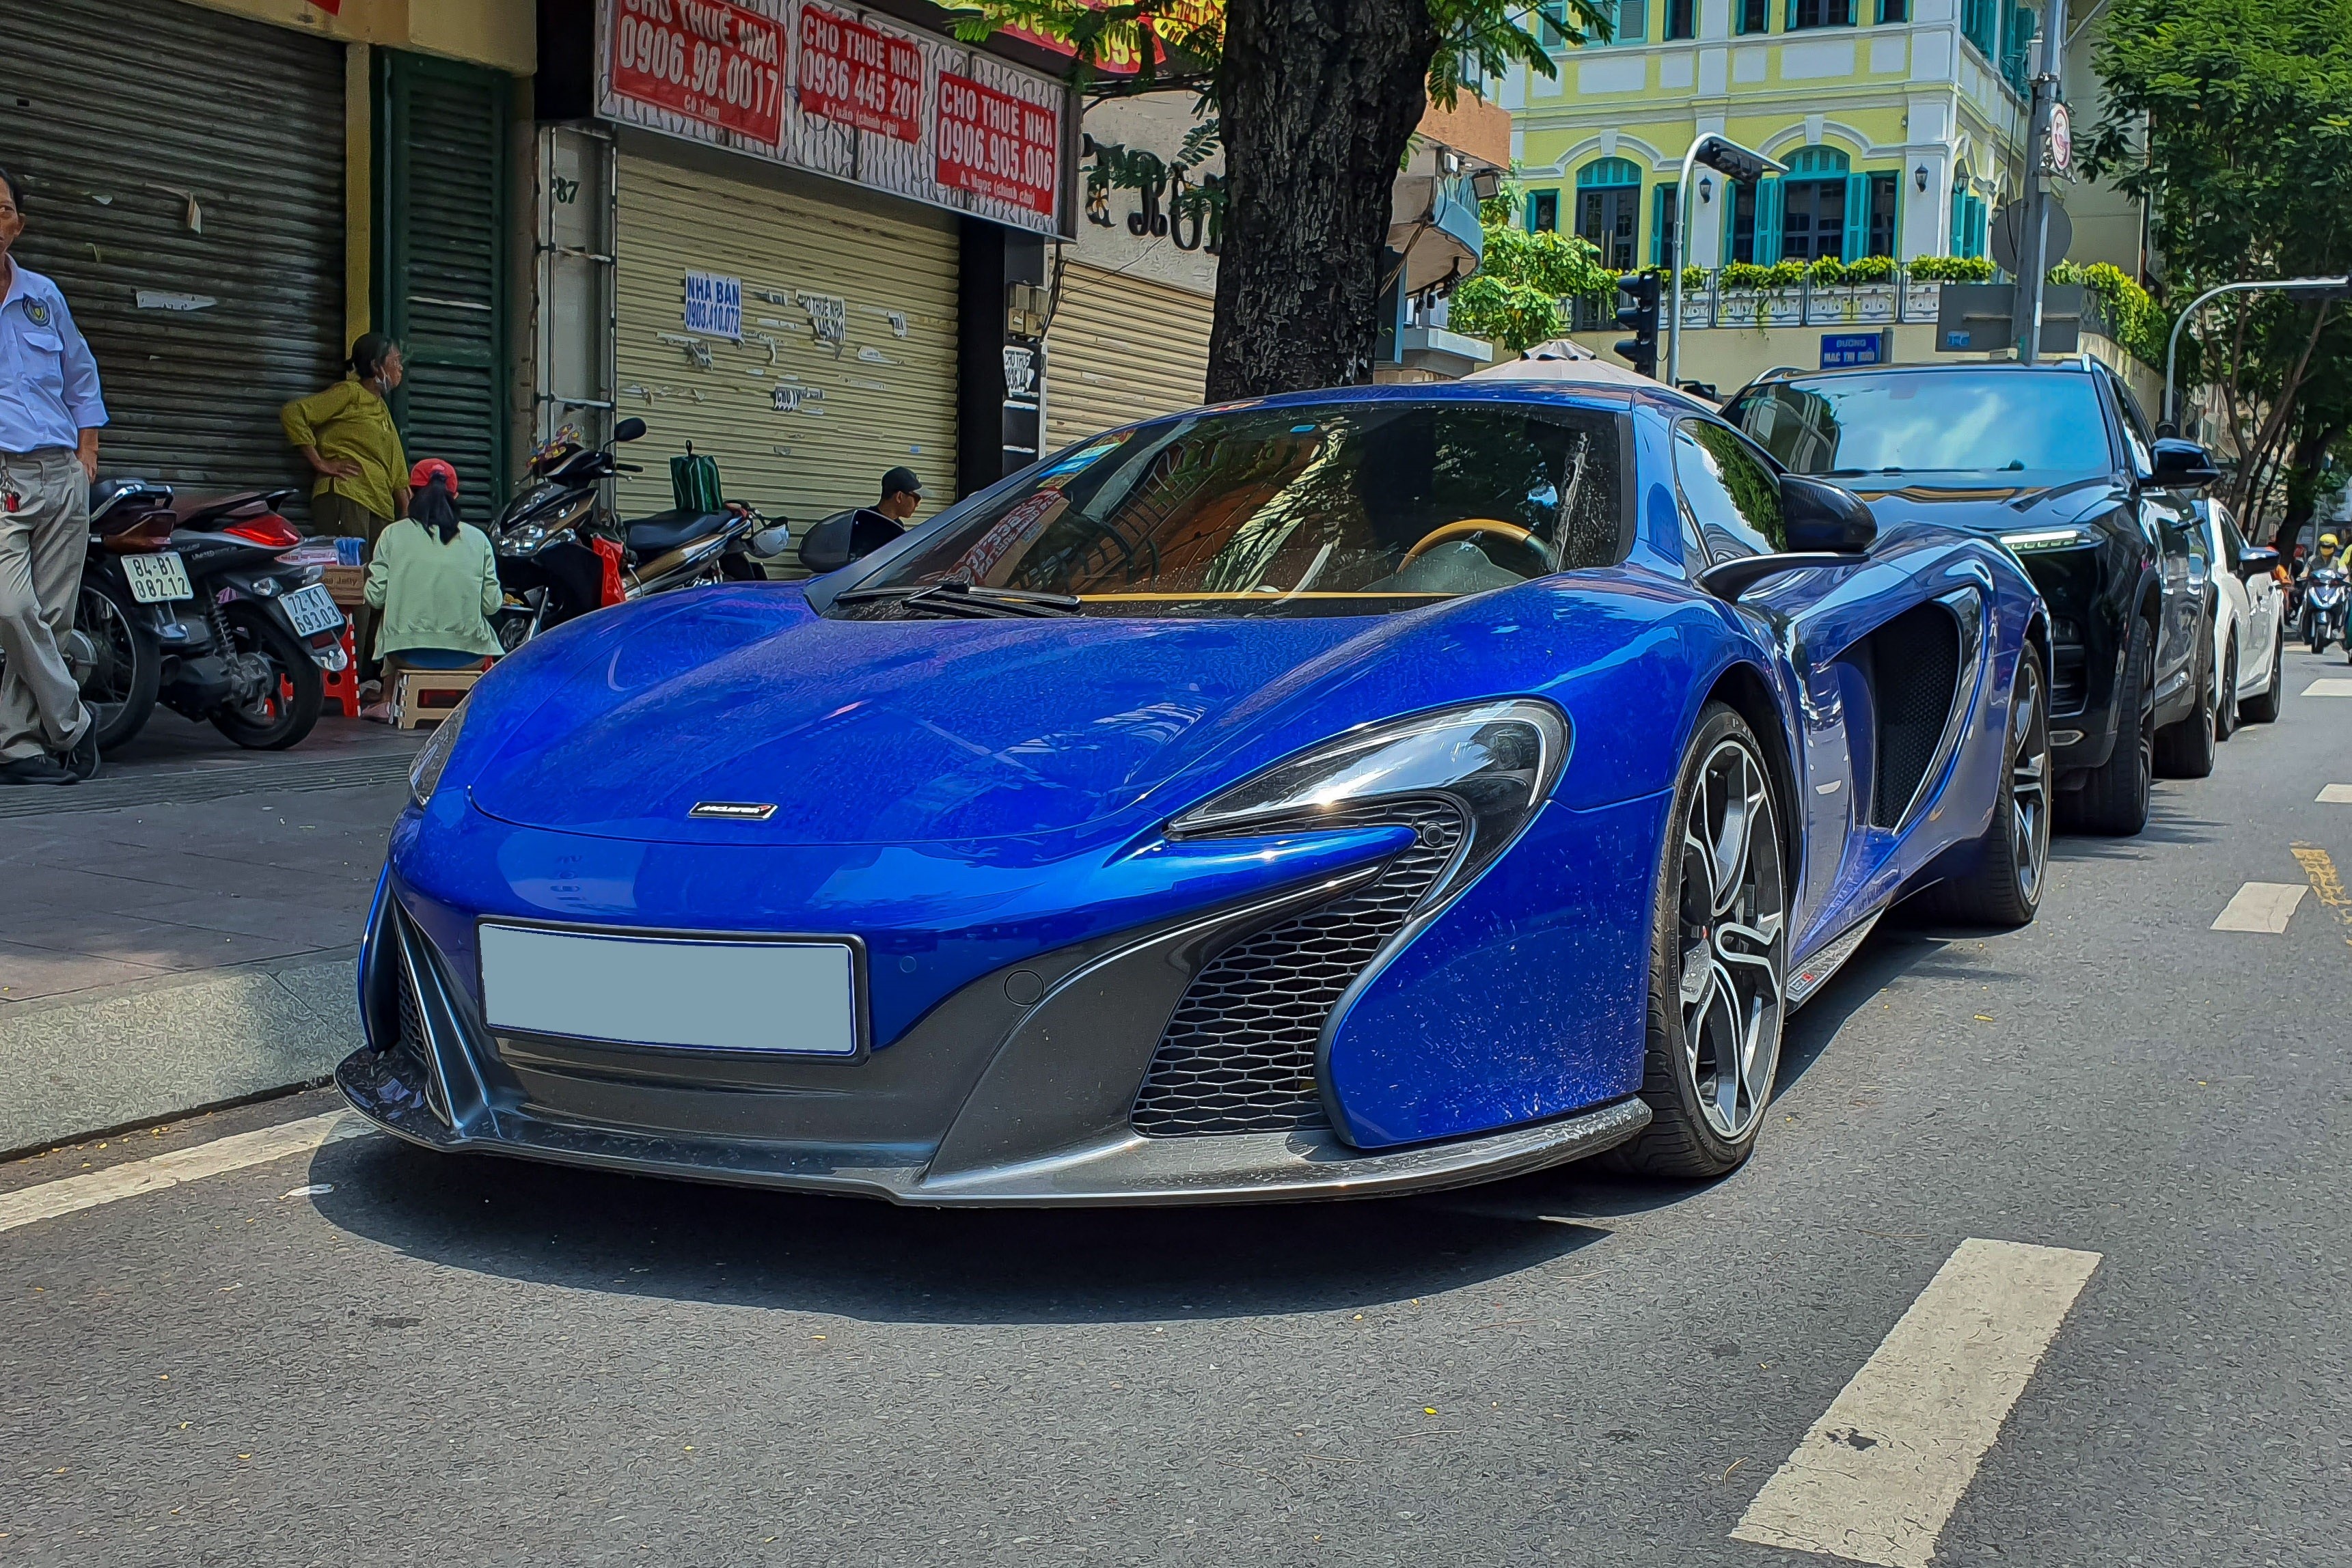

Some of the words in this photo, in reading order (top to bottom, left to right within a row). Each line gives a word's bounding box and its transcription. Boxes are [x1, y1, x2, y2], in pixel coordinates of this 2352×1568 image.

[620, 14, 779, 118] 0906.98.0017
[803, 14, 840, 54] CHO
[845, 29, 885, 71] THUÊ
[802, 48, 849, 100] 0936
[854, 66, 886, 113] 445
[890, 78, 918, 124] 201
[940, 81, 976, 122] CHO
[981, 95, 1020, 136] THUÊ
[939, 117, 1053, 192] 0906.905.006
[685, 299, 741, 335] 0903.410.073
[687, 273, 712, 302] NHÀ
[715, 277, 740, 307] BÁN
[135, 577, 189, 599] 882.12
[295, 606, 339, 633] 693.03
